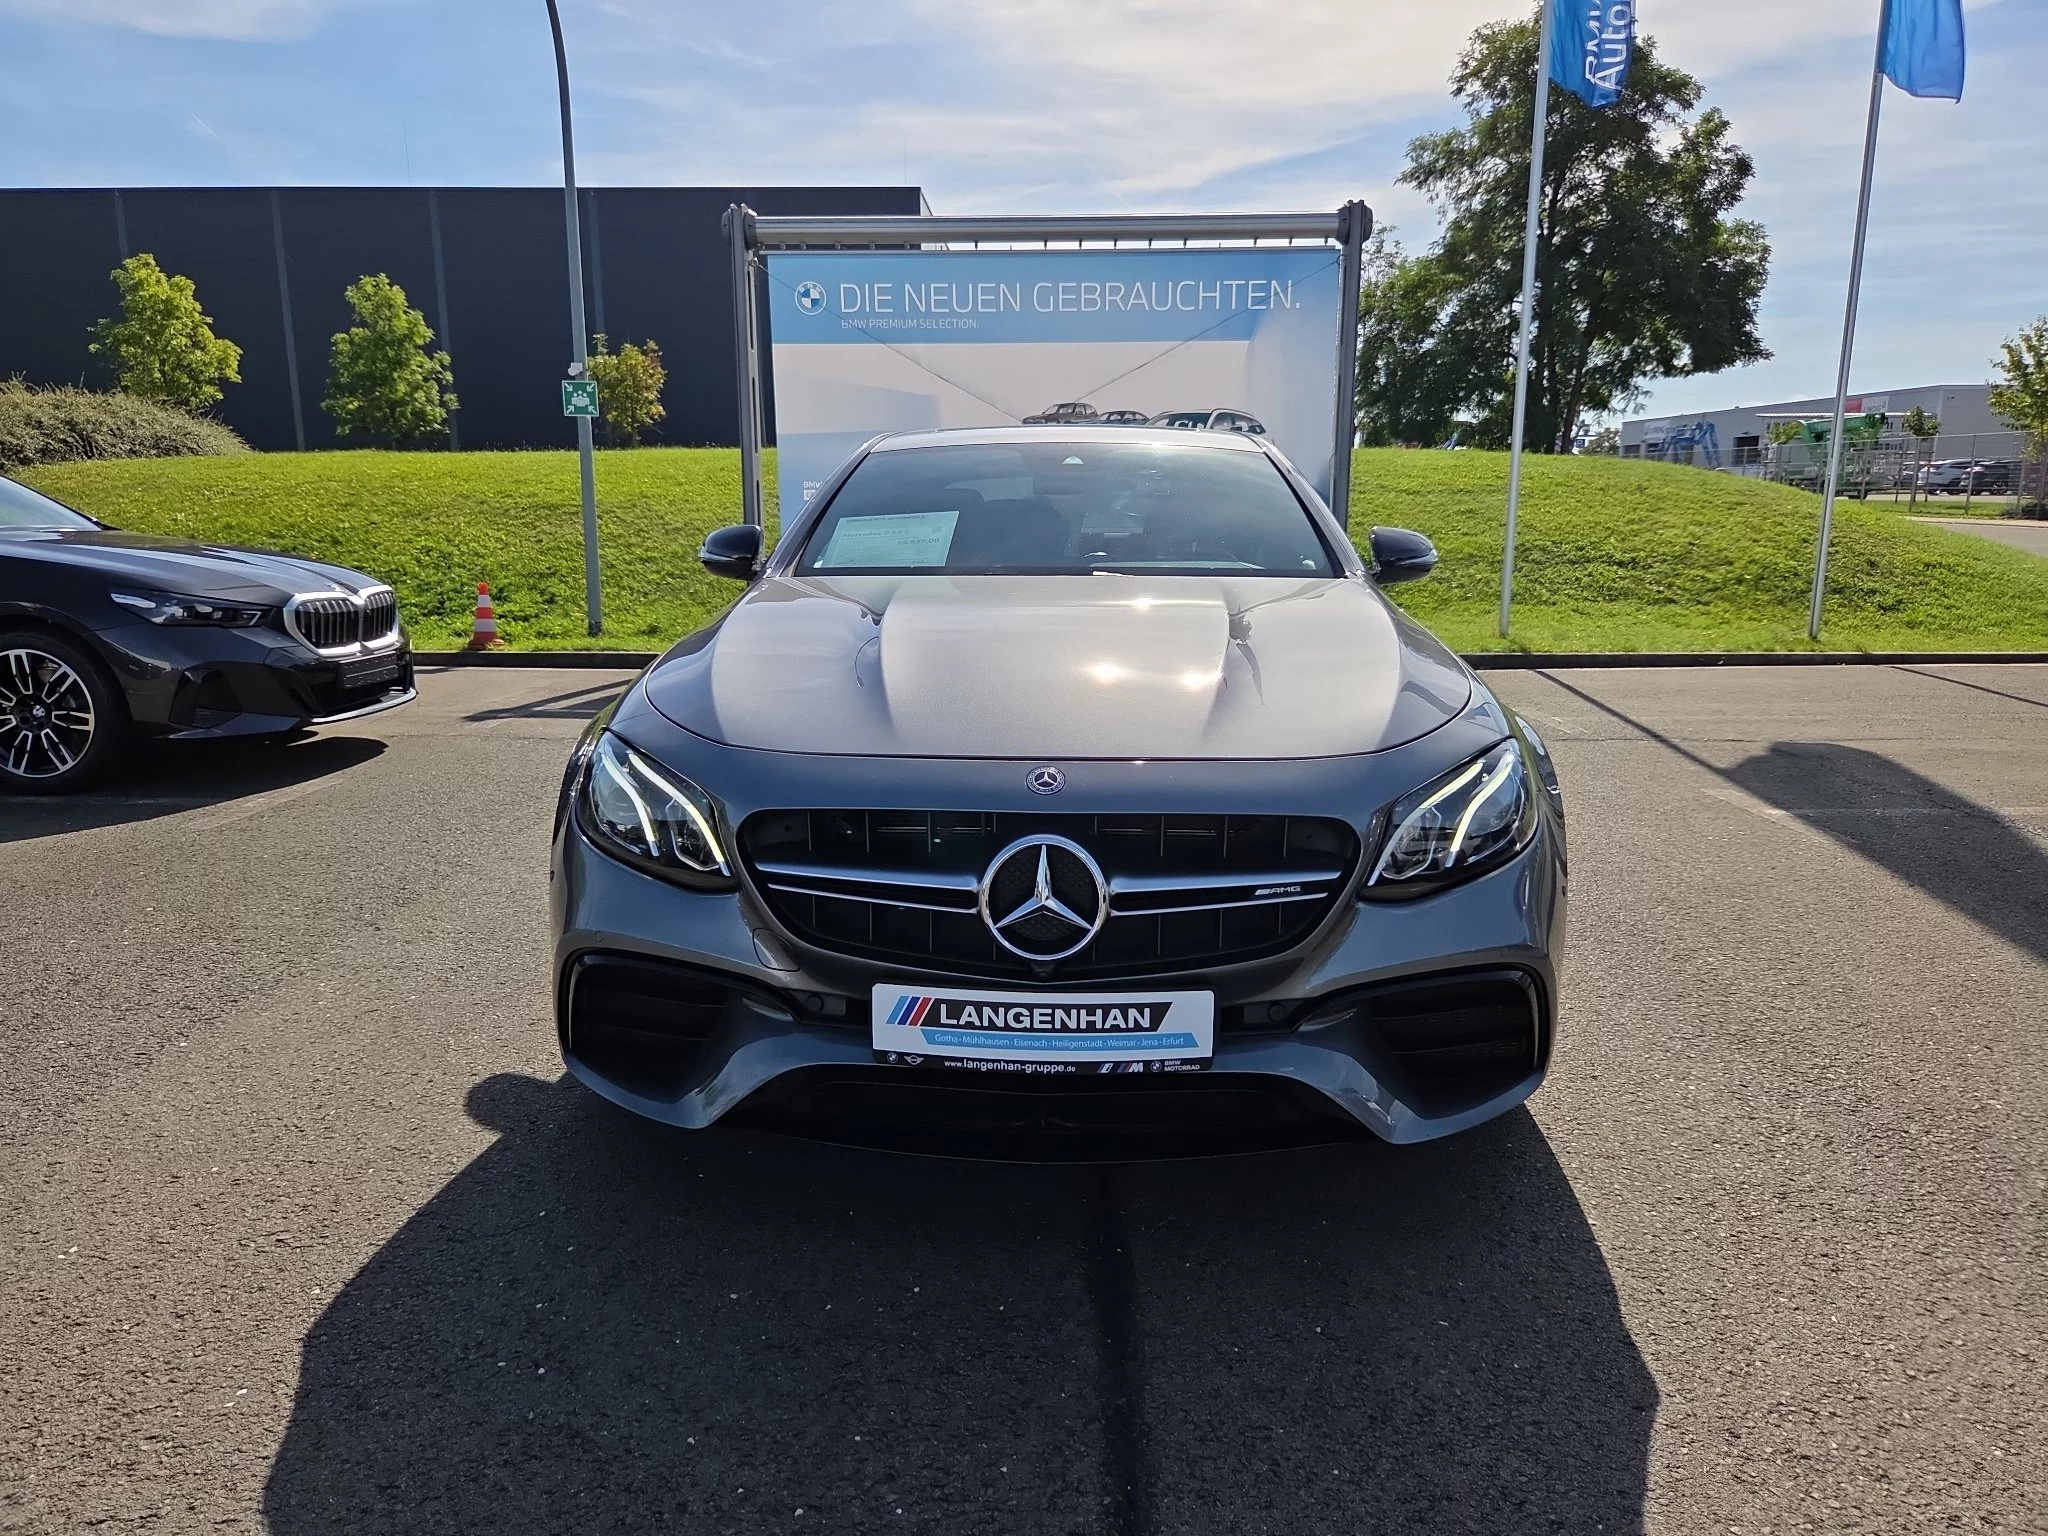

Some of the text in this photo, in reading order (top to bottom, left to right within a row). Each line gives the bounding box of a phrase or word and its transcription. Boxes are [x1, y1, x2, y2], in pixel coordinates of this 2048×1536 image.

[1594, 0, 1630, 90] Auto
[840, 280, 1300, 312] DIE NEUEN GEBRAUCHTEN.
[841, 319, 979, 329] BMW PREMIUM SELECTION.
[1269, 885, 1301, 894] AMG
[940, 1003, 1151, 1029] LANGENHAN
[934, 1033, 1184, 1049] Gotha Mühlhausen Eisenach Heiligenstadt Weimar Jena Erfurt
[944, 1058, 1076, 1074] www.langenhan-gruppe.de
